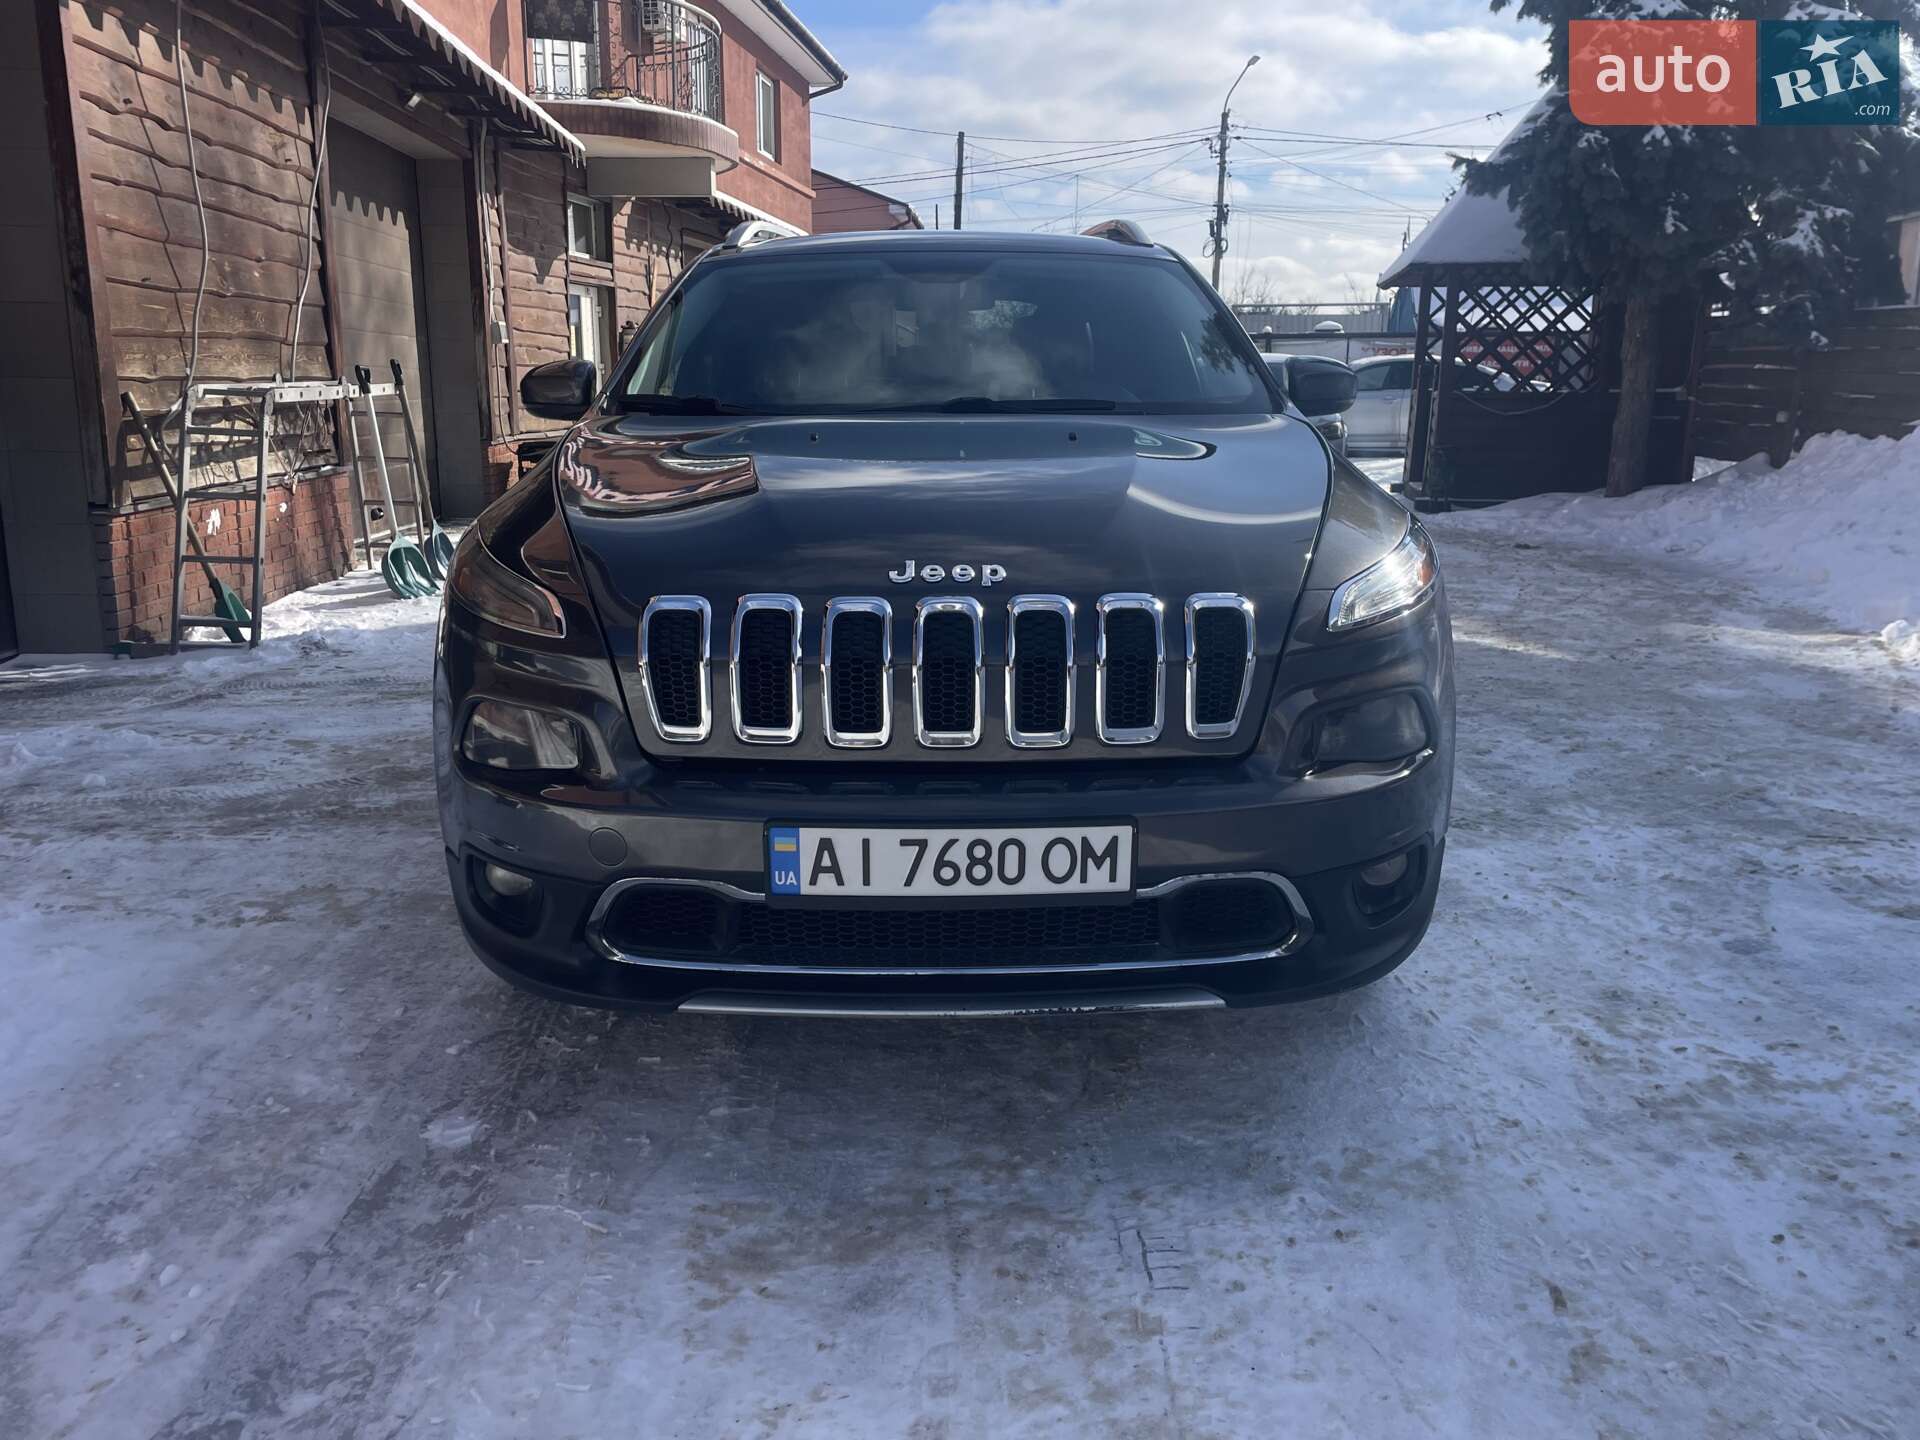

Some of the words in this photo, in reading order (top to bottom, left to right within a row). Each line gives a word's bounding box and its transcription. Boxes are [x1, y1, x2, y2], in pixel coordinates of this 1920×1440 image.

[888, 559, 1007, 587] Jeep
[808, 837, 872, 887] AI
[899, 837, 1027, 887] 7680
[1040, 834, 1120, 885] OM
[775, 870, 798, 886] UA
